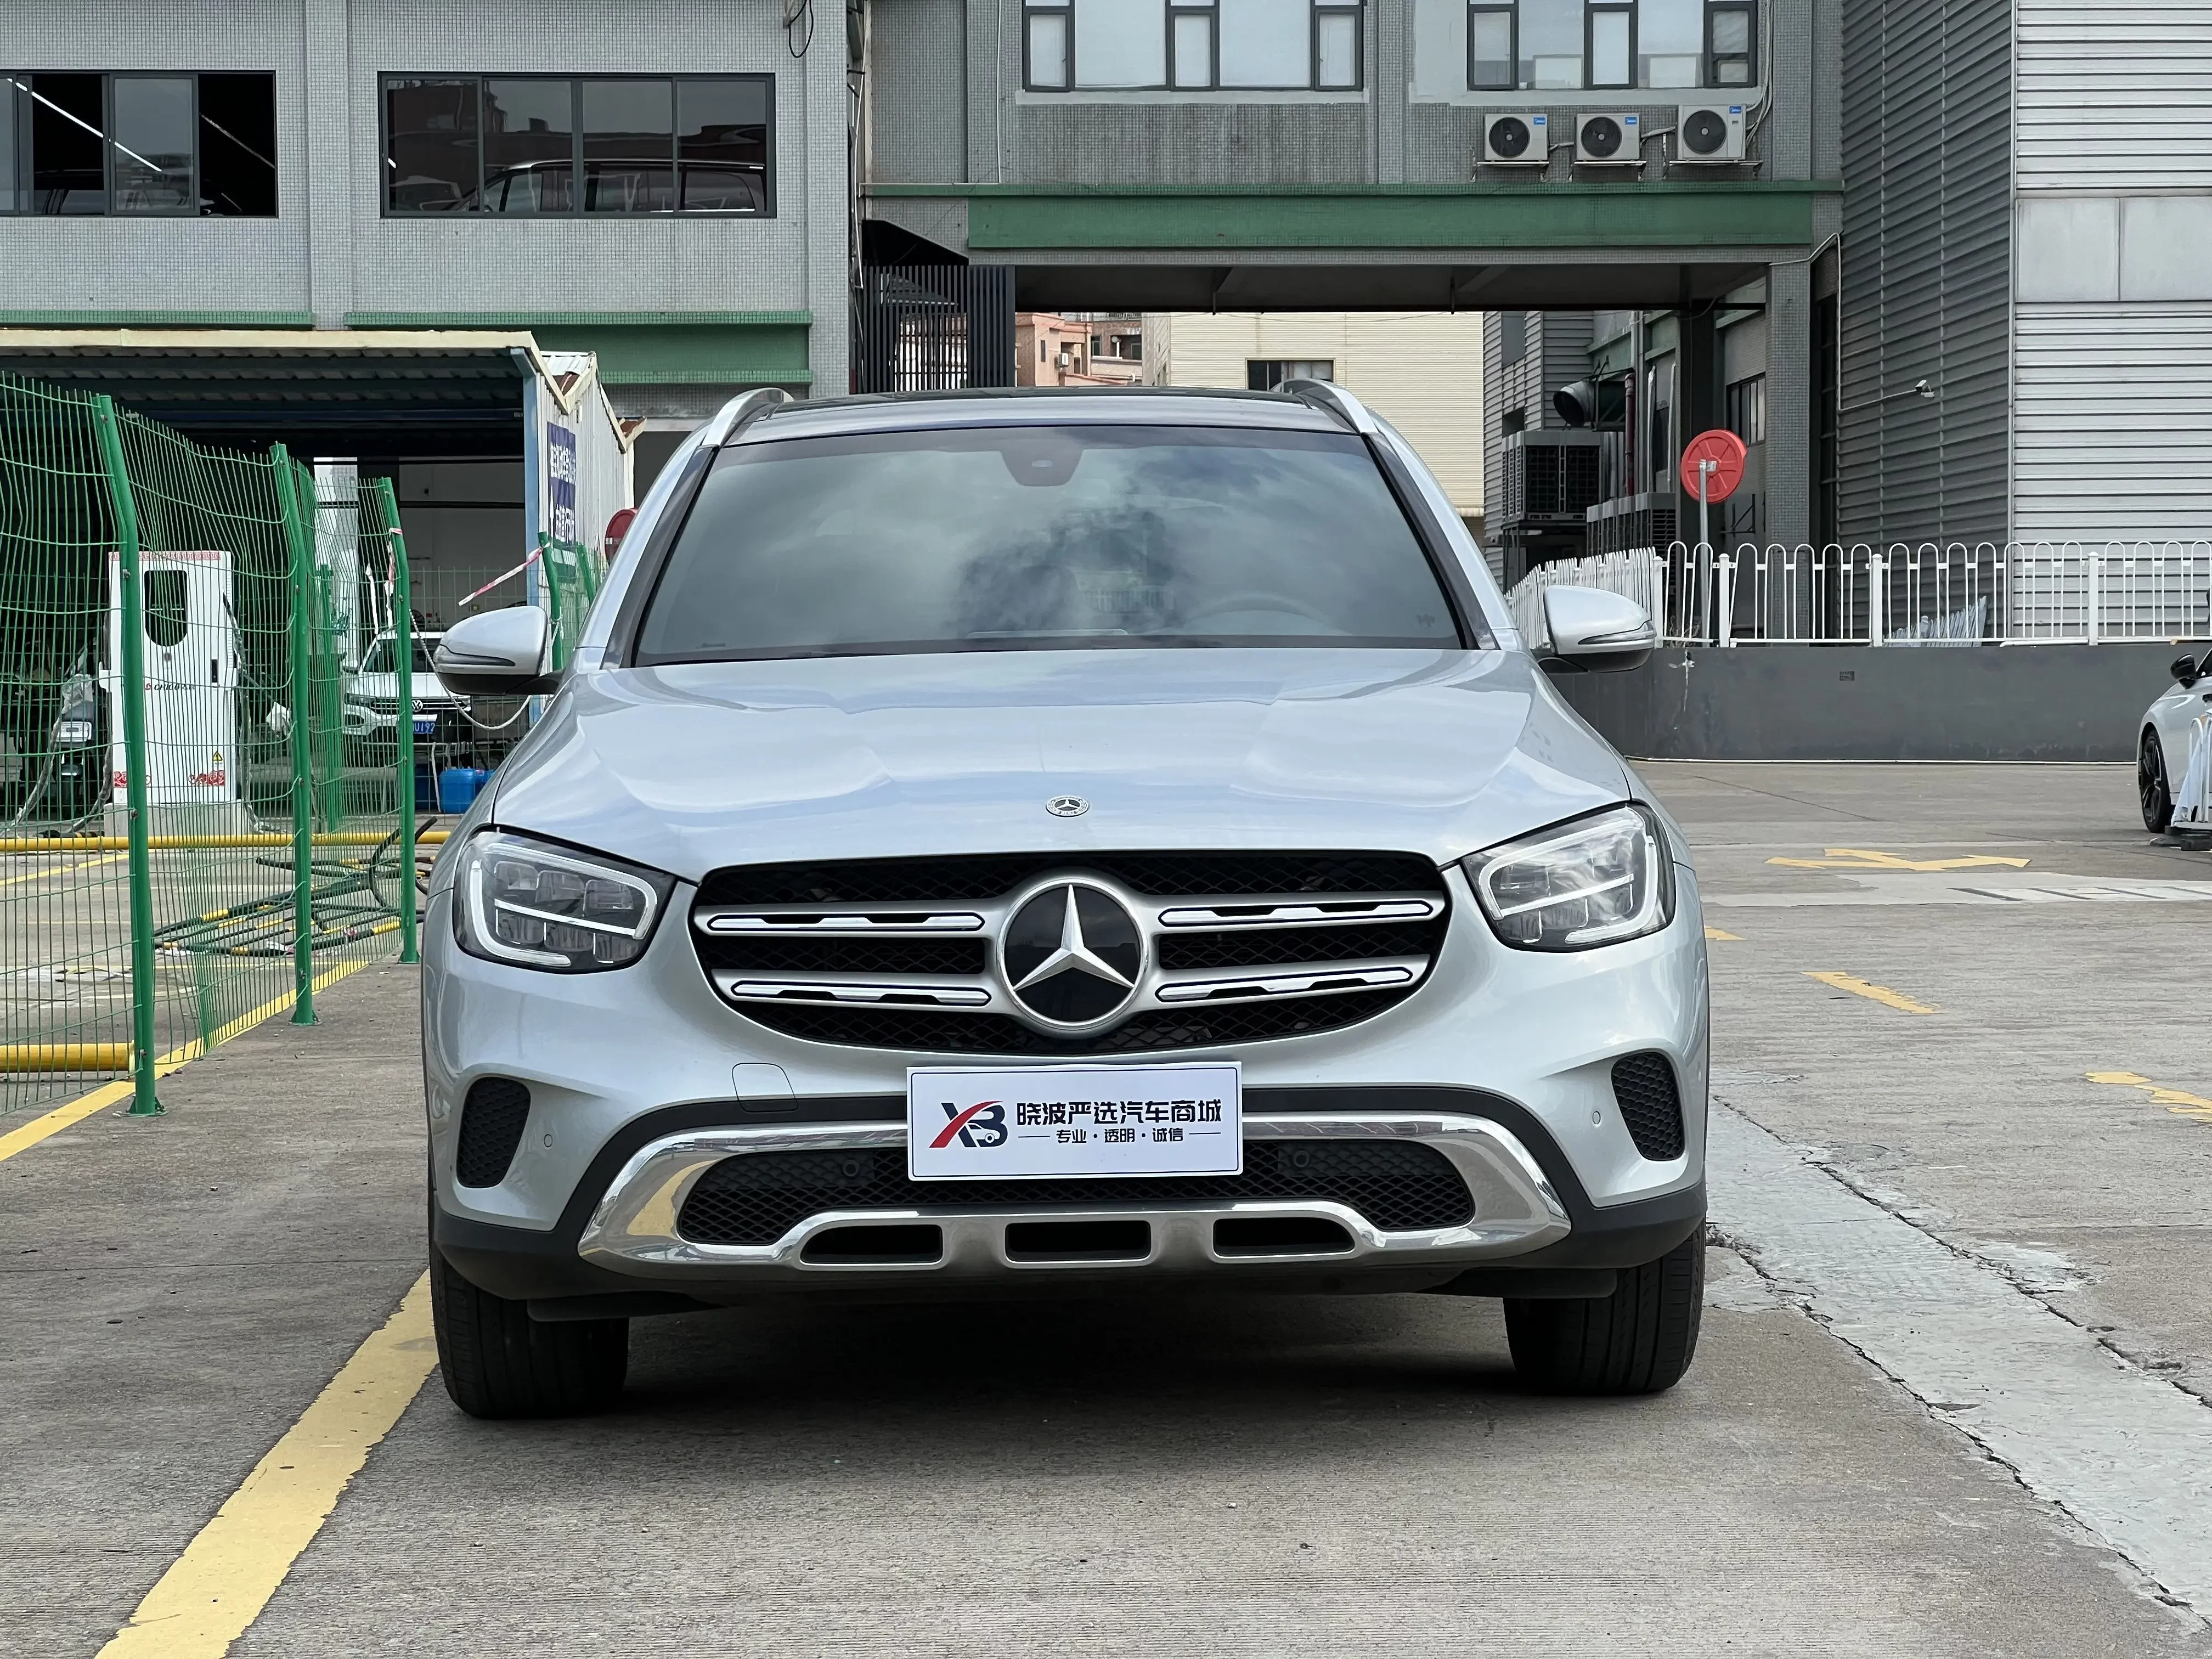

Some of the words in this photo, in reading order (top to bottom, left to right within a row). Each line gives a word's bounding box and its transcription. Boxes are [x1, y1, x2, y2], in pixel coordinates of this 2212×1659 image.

[413, 722, 435, 733] U192
[1017, 1099, 1221, 1125] 晓波严选汽车商城
